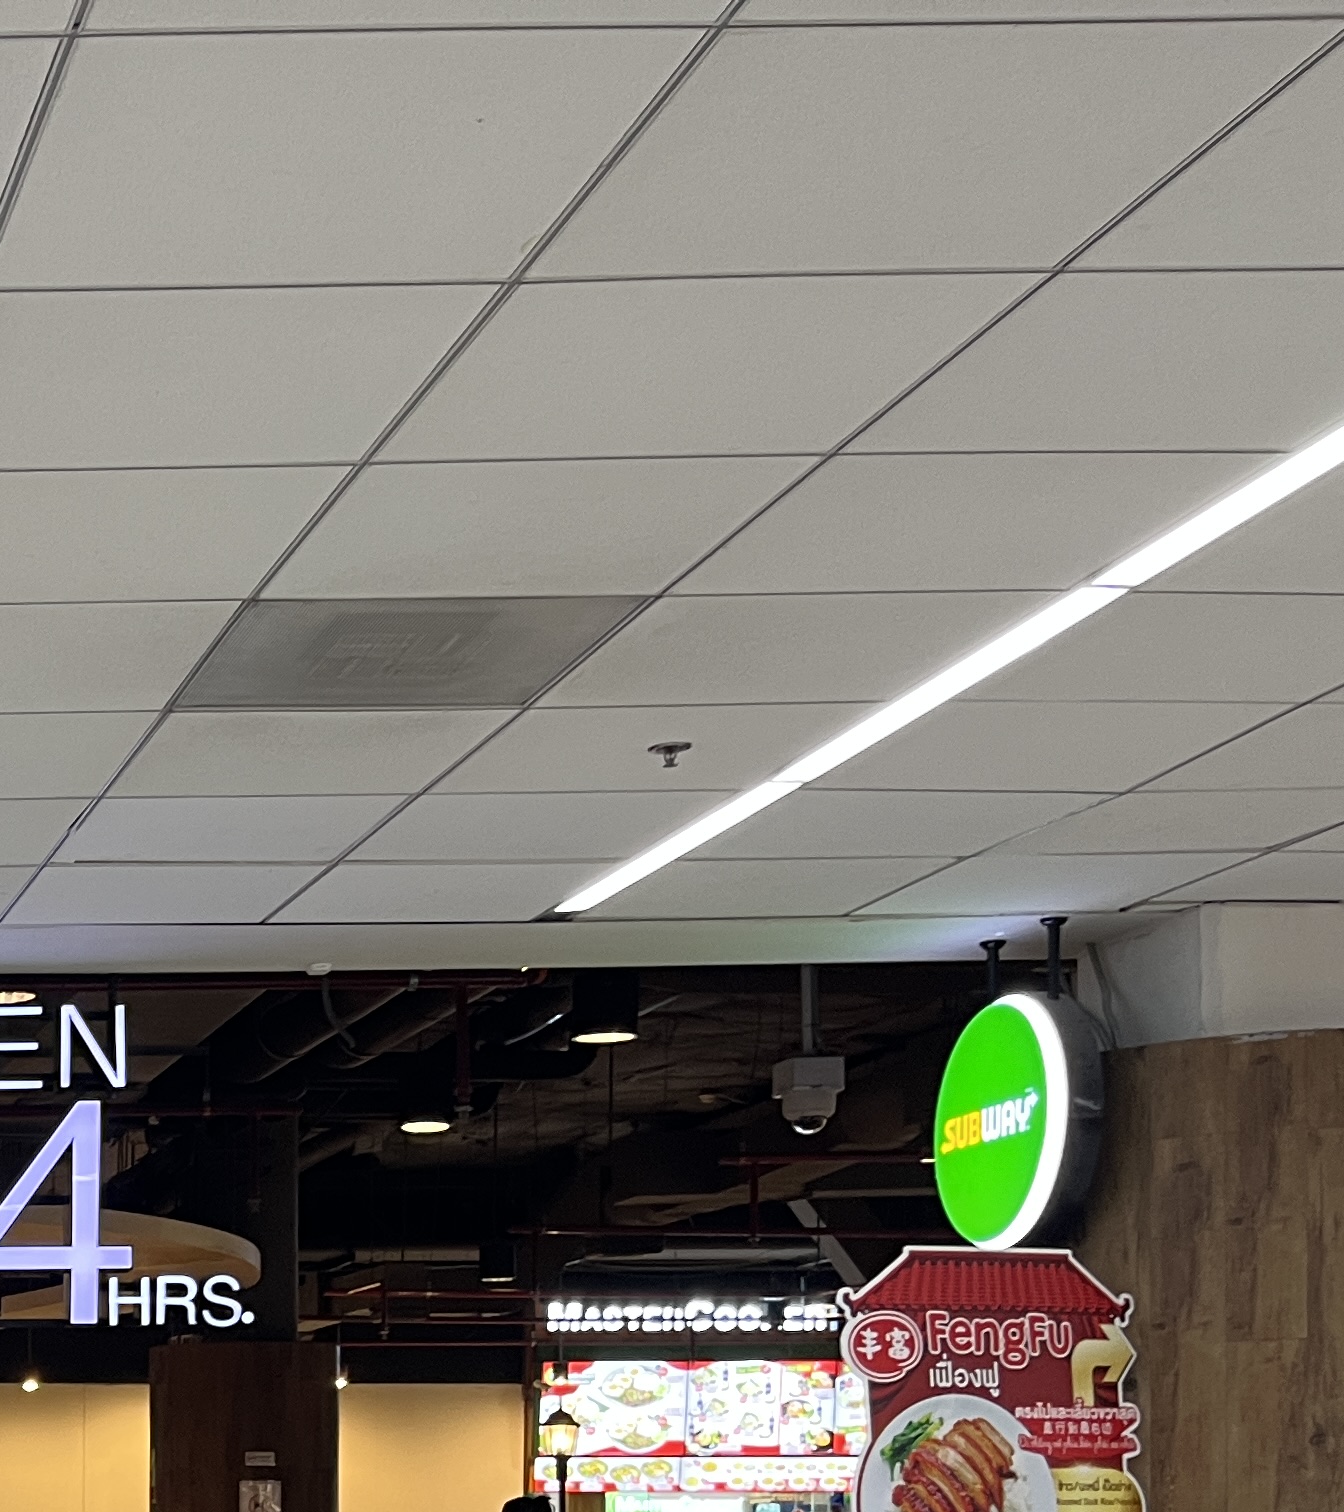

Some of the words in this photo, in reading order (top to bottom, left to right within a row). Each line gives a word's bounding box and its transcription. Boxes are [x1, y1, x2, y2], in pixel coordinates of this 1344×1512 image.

[940, 1088, 1039, 1155] SUBWAY
[107, 1275, 255, 1327] HRS.
[925, 1310, 1073, 1369] FengFu
